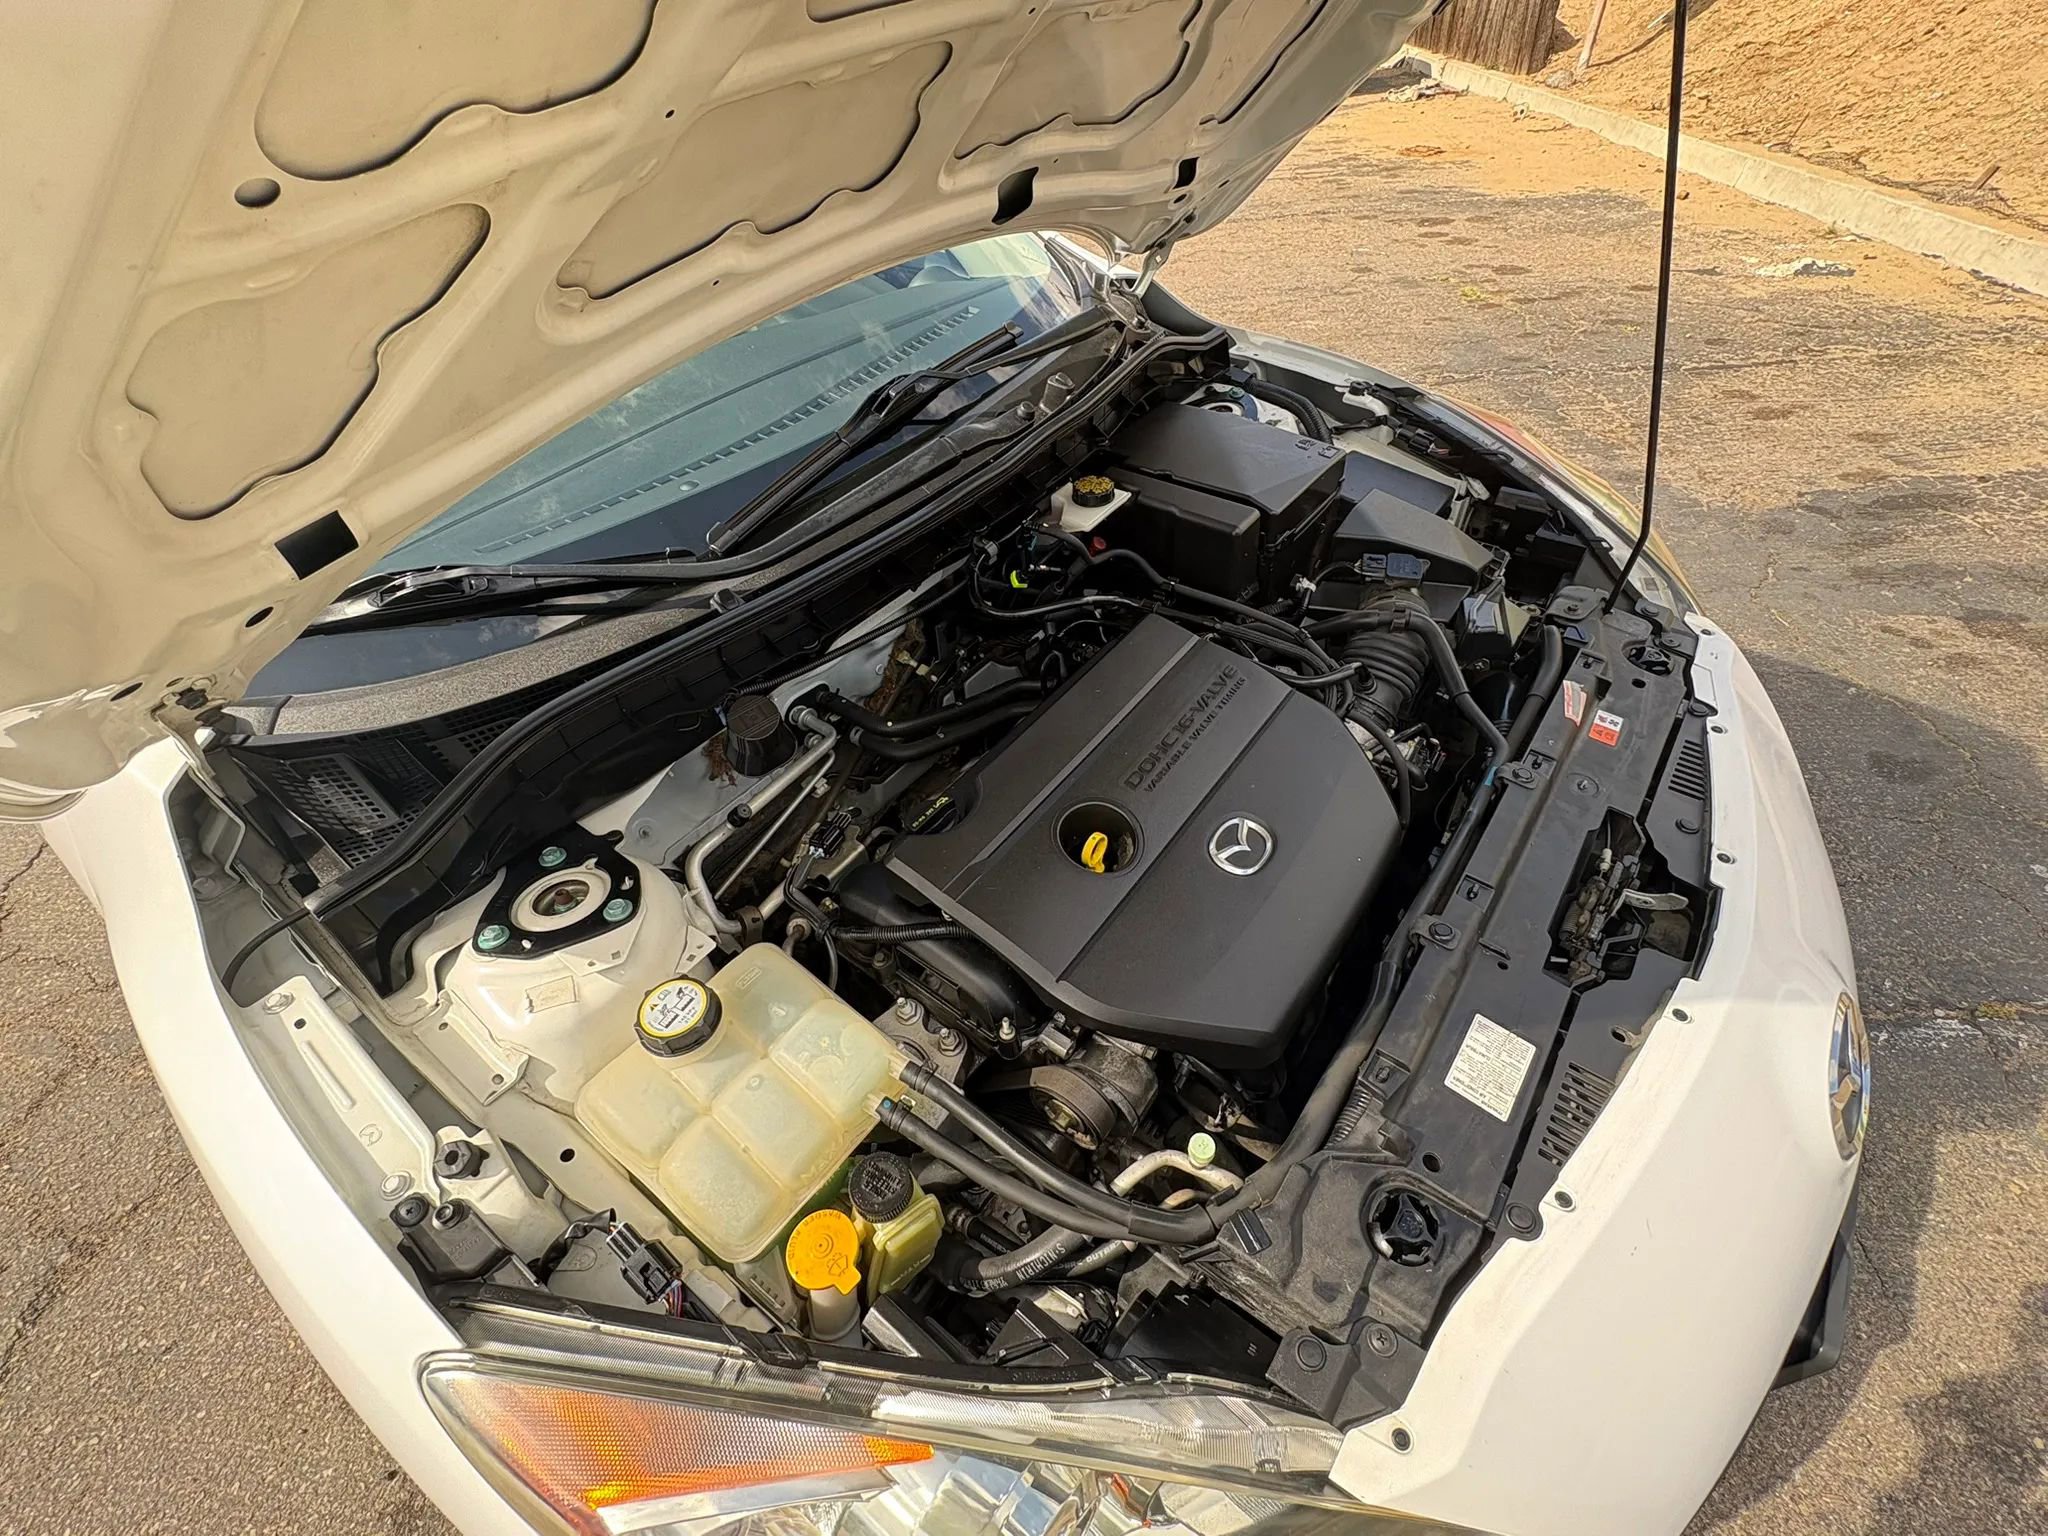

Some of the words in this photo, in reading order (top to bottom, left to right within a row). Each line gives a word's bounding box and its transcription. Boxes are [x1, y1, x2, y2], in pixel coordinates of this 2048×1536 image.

[1123, 732, 1179, 790] DOHC
[1172, 665, 1238, 734] 16-VALVE
[1144, 741, 1192, 792] VARIABLE
[1189, 711, 1217, 740] VALVE
[1215, 677, 1246, 710] TIMING
